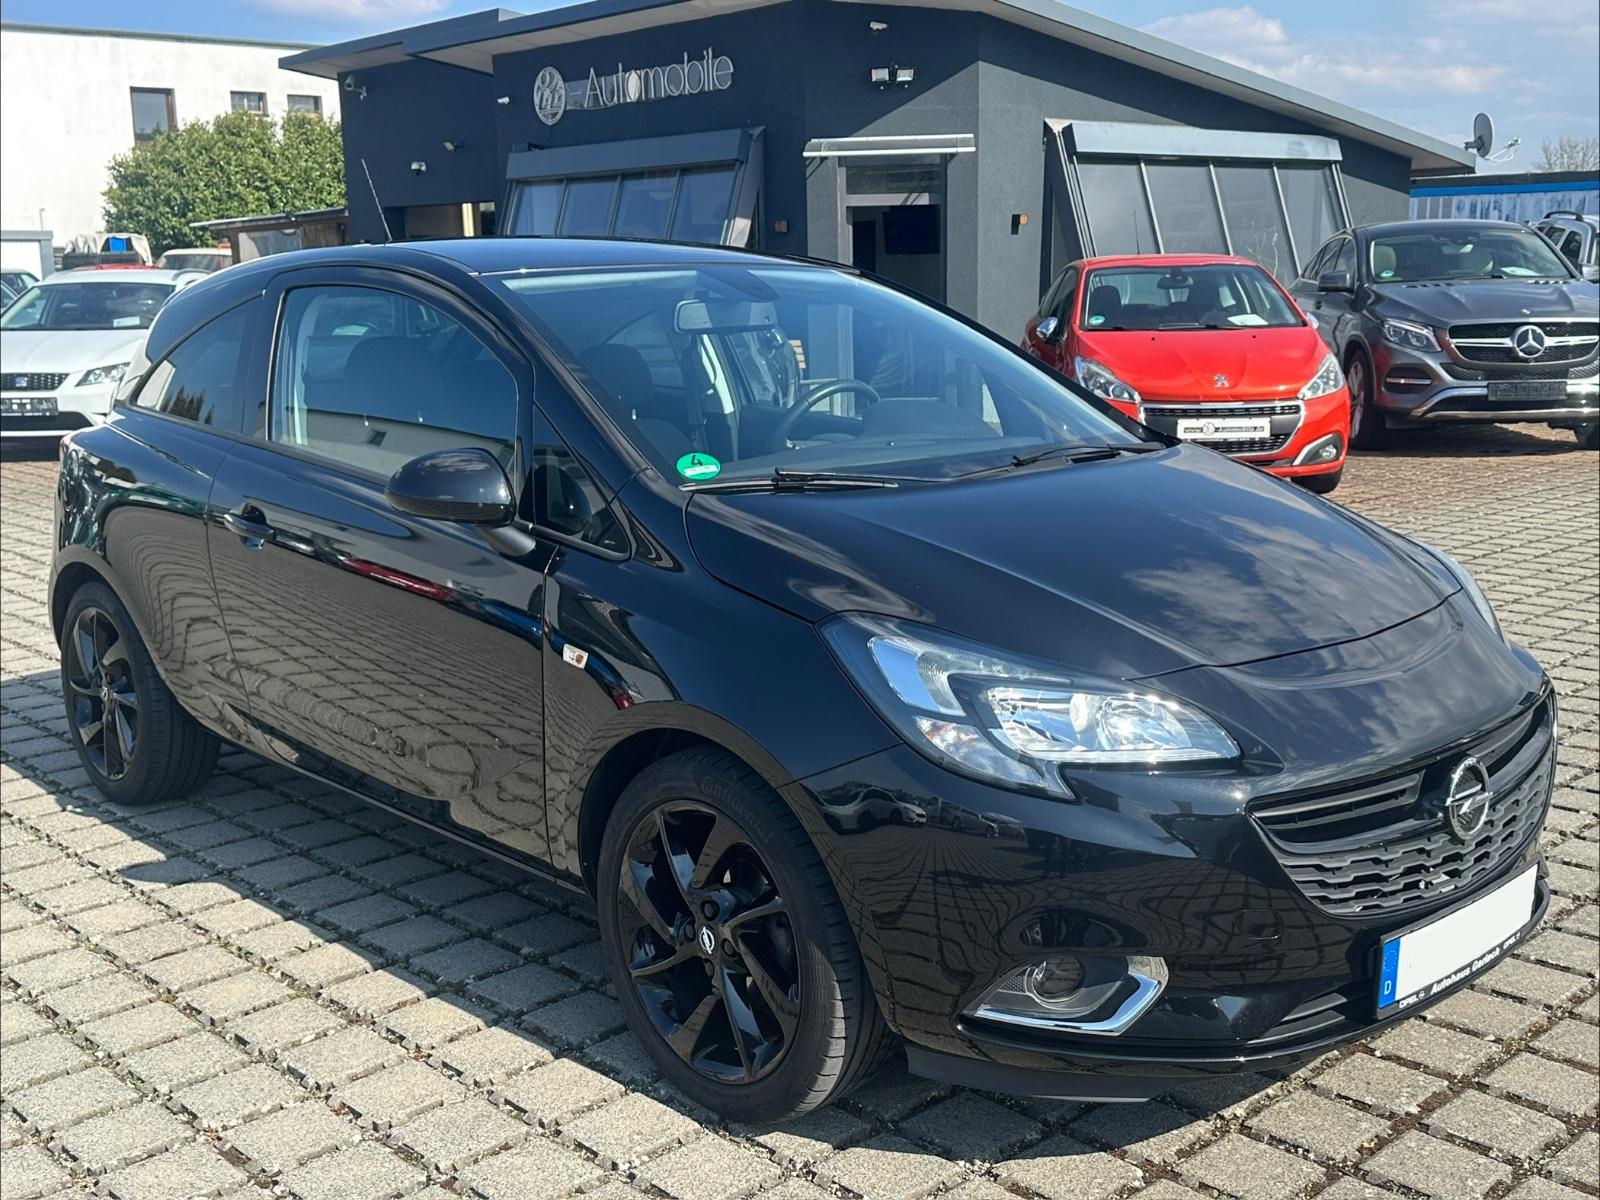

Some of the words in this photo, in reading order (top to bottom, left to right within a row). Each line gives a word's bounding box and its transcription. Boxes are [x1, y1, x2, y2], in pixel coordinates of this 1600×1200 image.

[691, 453, 704, 467] 4
[1384, 980, 1392, 996] D
[1430, 967, 1470, 995] Autohaus
